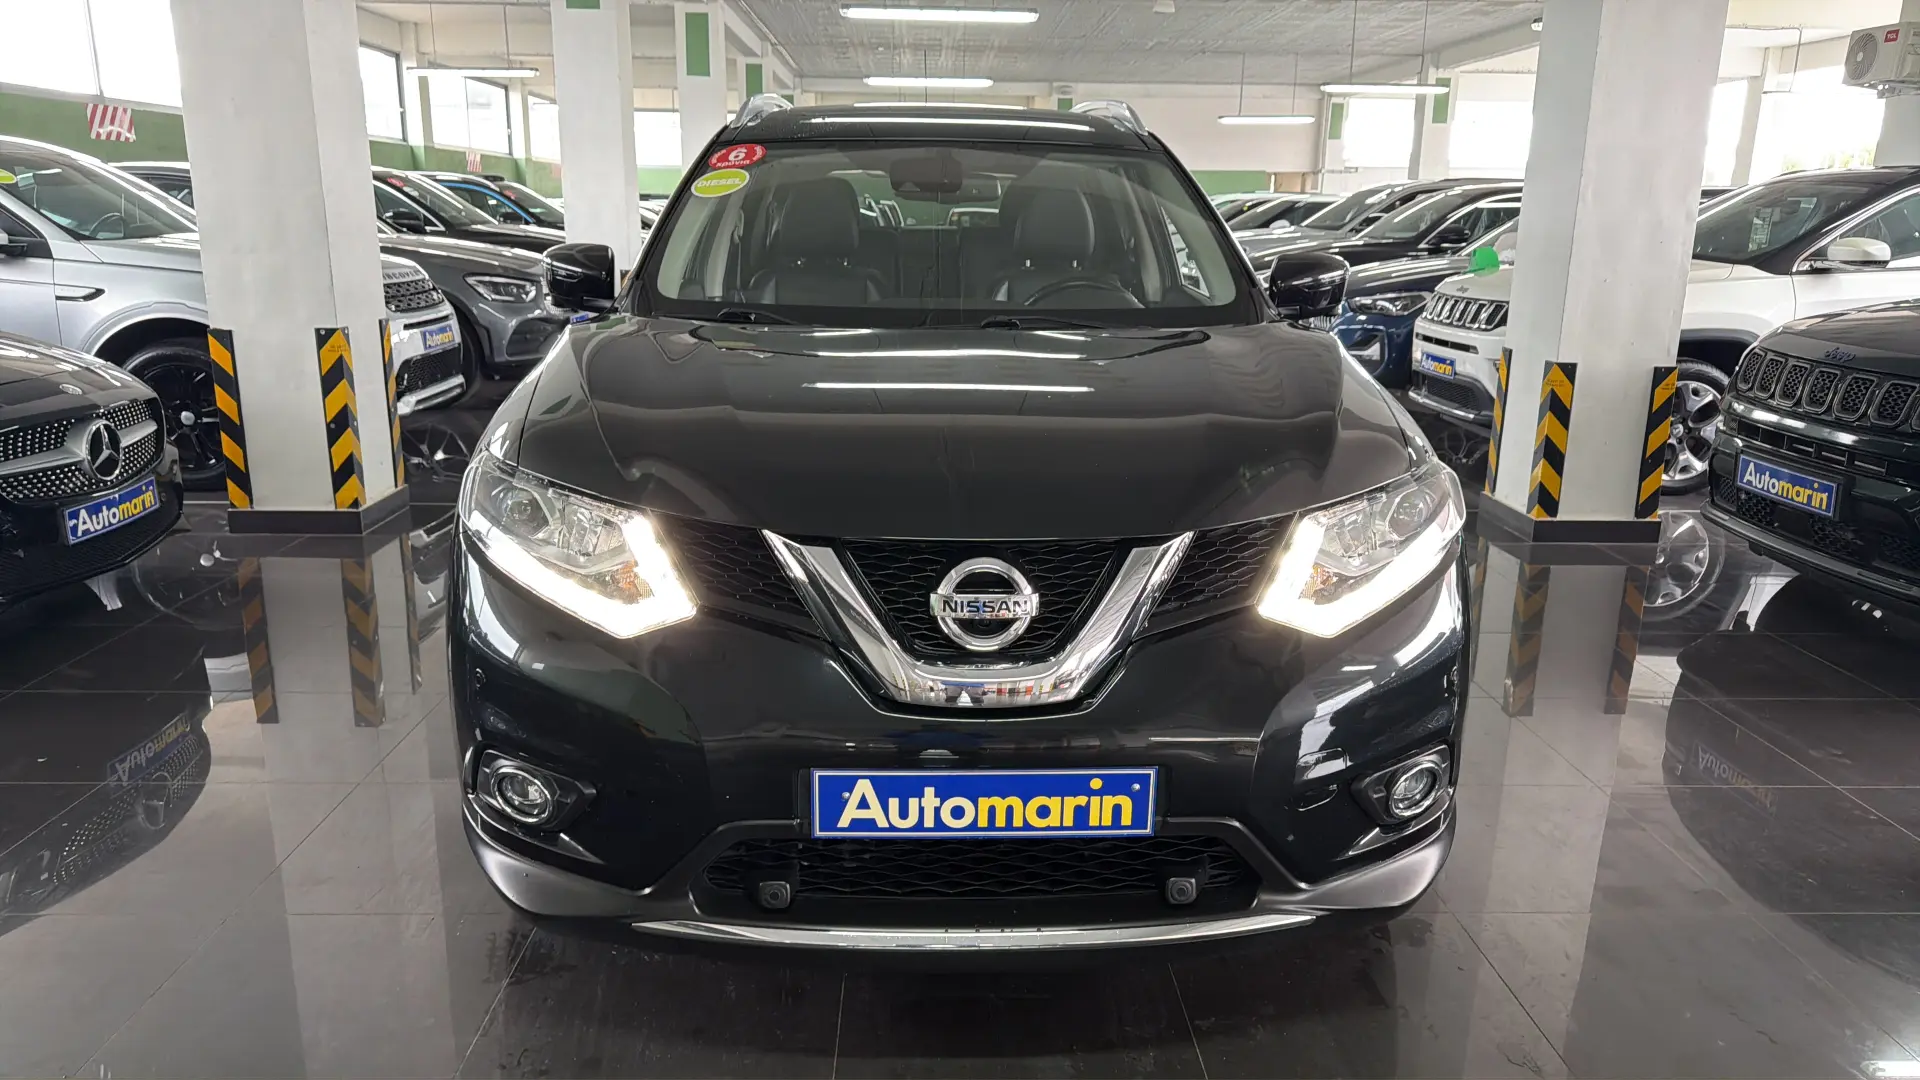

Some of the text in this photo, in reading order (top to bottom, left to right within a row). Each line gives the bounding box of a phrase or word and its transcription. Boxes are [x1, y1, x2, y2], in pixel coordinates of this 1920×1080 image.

[728, 148, 748, 161] 6
[697, 178, 742, 188] DIESEL
[1742, 461, 1829, 511] Automarin
[77, 484, 155, 537] Automarin
[942, 599, 1028, 614] NISSAN
[837, 777, 1132, 829] Automarin
